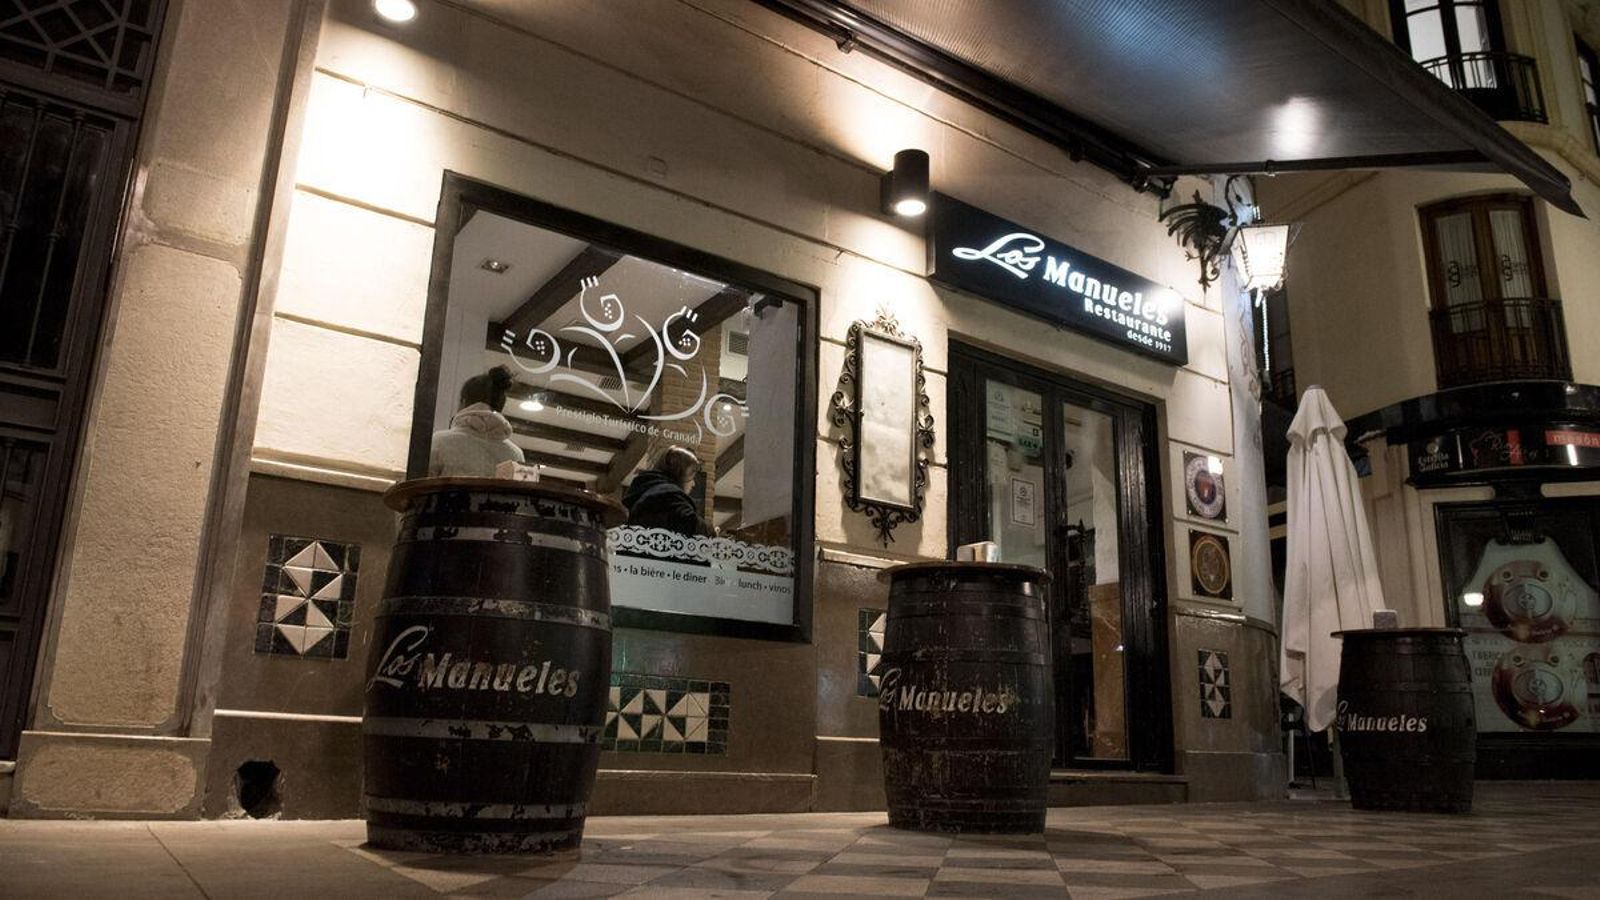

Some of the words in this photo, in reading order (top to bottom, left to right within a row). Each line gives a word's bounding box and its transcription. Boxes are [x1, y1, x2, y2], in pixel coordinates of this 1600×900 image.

[952, 232, 1045, 279] Los
[1043, 255, 1170, 327] Manueles
[1084, 297, 1172, 343] Restaurante
[1127, 329, 1153, 347] desde
[556, 405, 602, 425] Prestigio
[648, 425, 660, 437] de
[629, 565, 639, 576] la
[672, 569, 682, 581] le
[738, 578, 762, 591] lunch
[768, 582, 792, 595] vinos
[366, 625, 434, 693] Los
[418, 652, 580, 698] Manueles
[898, 685, 1010, 714] Manueles
[1347, 712, 1428, 733] Manueles
